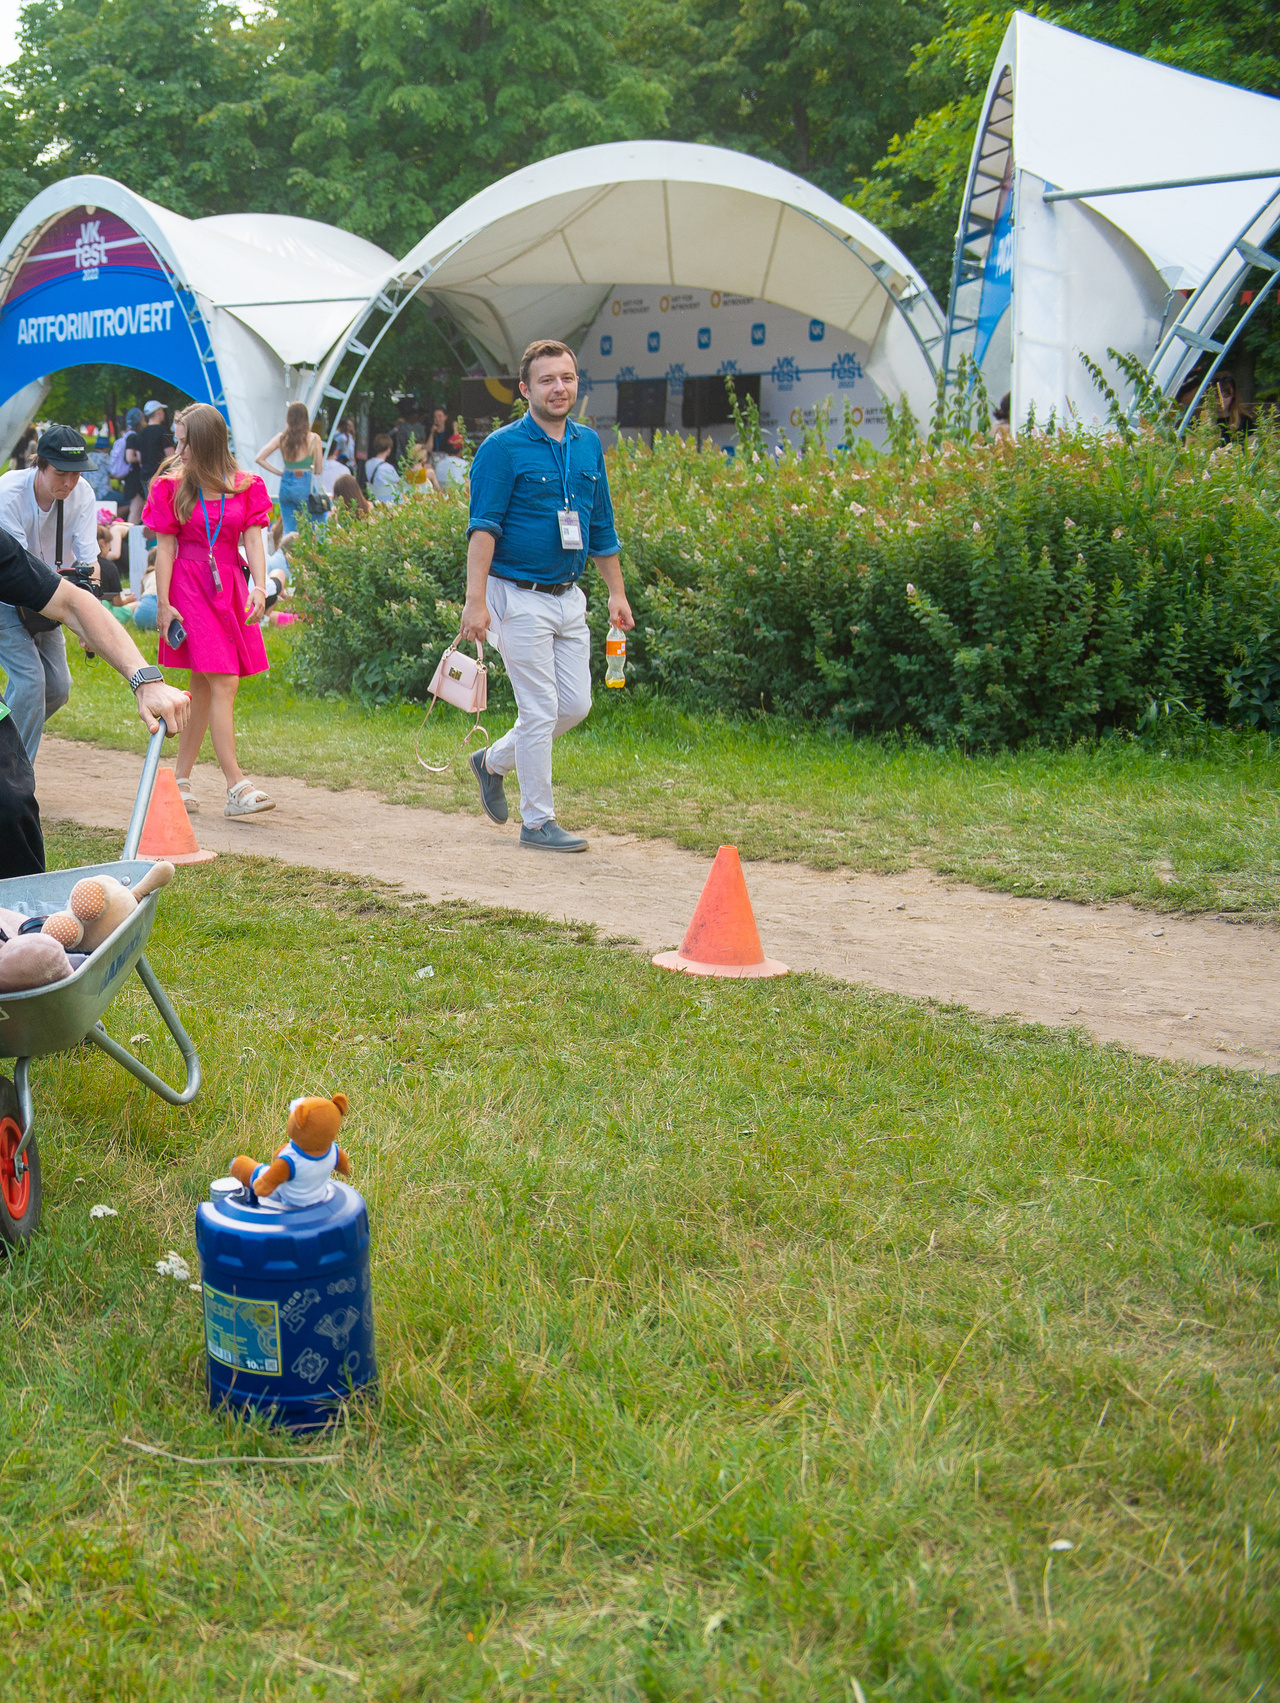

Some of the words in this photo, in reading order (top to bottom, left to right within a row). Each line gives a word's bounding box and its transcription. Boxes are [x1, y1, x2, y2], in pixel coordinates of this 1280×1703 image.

[81, 220, 100, 243] VK
[75, 236, 108, 268] fest
[17, 300, 174, 344] ARTFORINTROVERT
[777, 356, 795, 369] VK
[837, 352, 857, 365] VK
[771, 364, 801, 383] fest
[831, 361, 863, 380] fest
